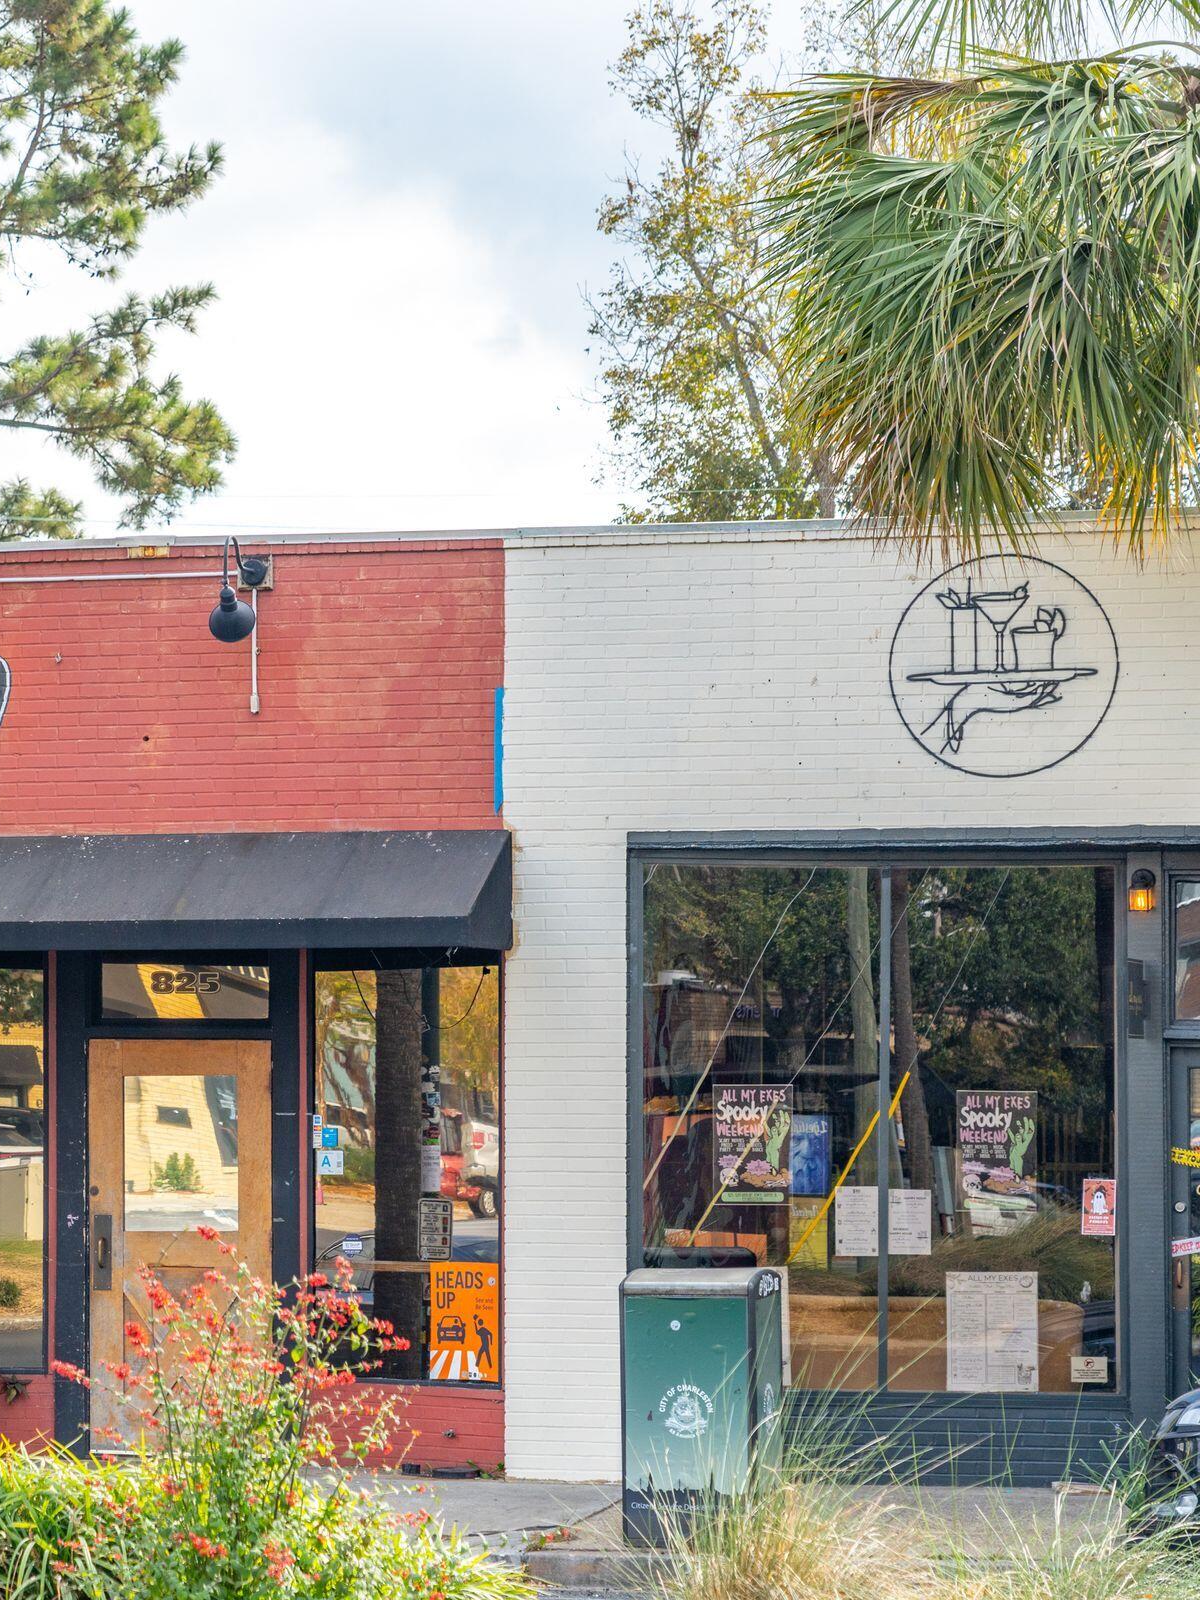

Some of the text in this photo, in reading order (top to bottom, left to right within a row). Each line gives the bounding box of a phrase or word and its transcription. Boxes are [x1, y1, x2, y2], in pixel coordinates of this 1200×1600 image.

[151, 971, 221, 995] 825
[721, 1089, 786, 1103] ALL MY EXES
[966, 1095, 1031, 1110] ALL MY EXES
[321, 1155, 331, 1167] A
[436, 1271, 483, 1289] HEADS
[436, 1292, 455, 1309] UP
[659, 1384, 715, 1413] CITY OF CHARLESTON
